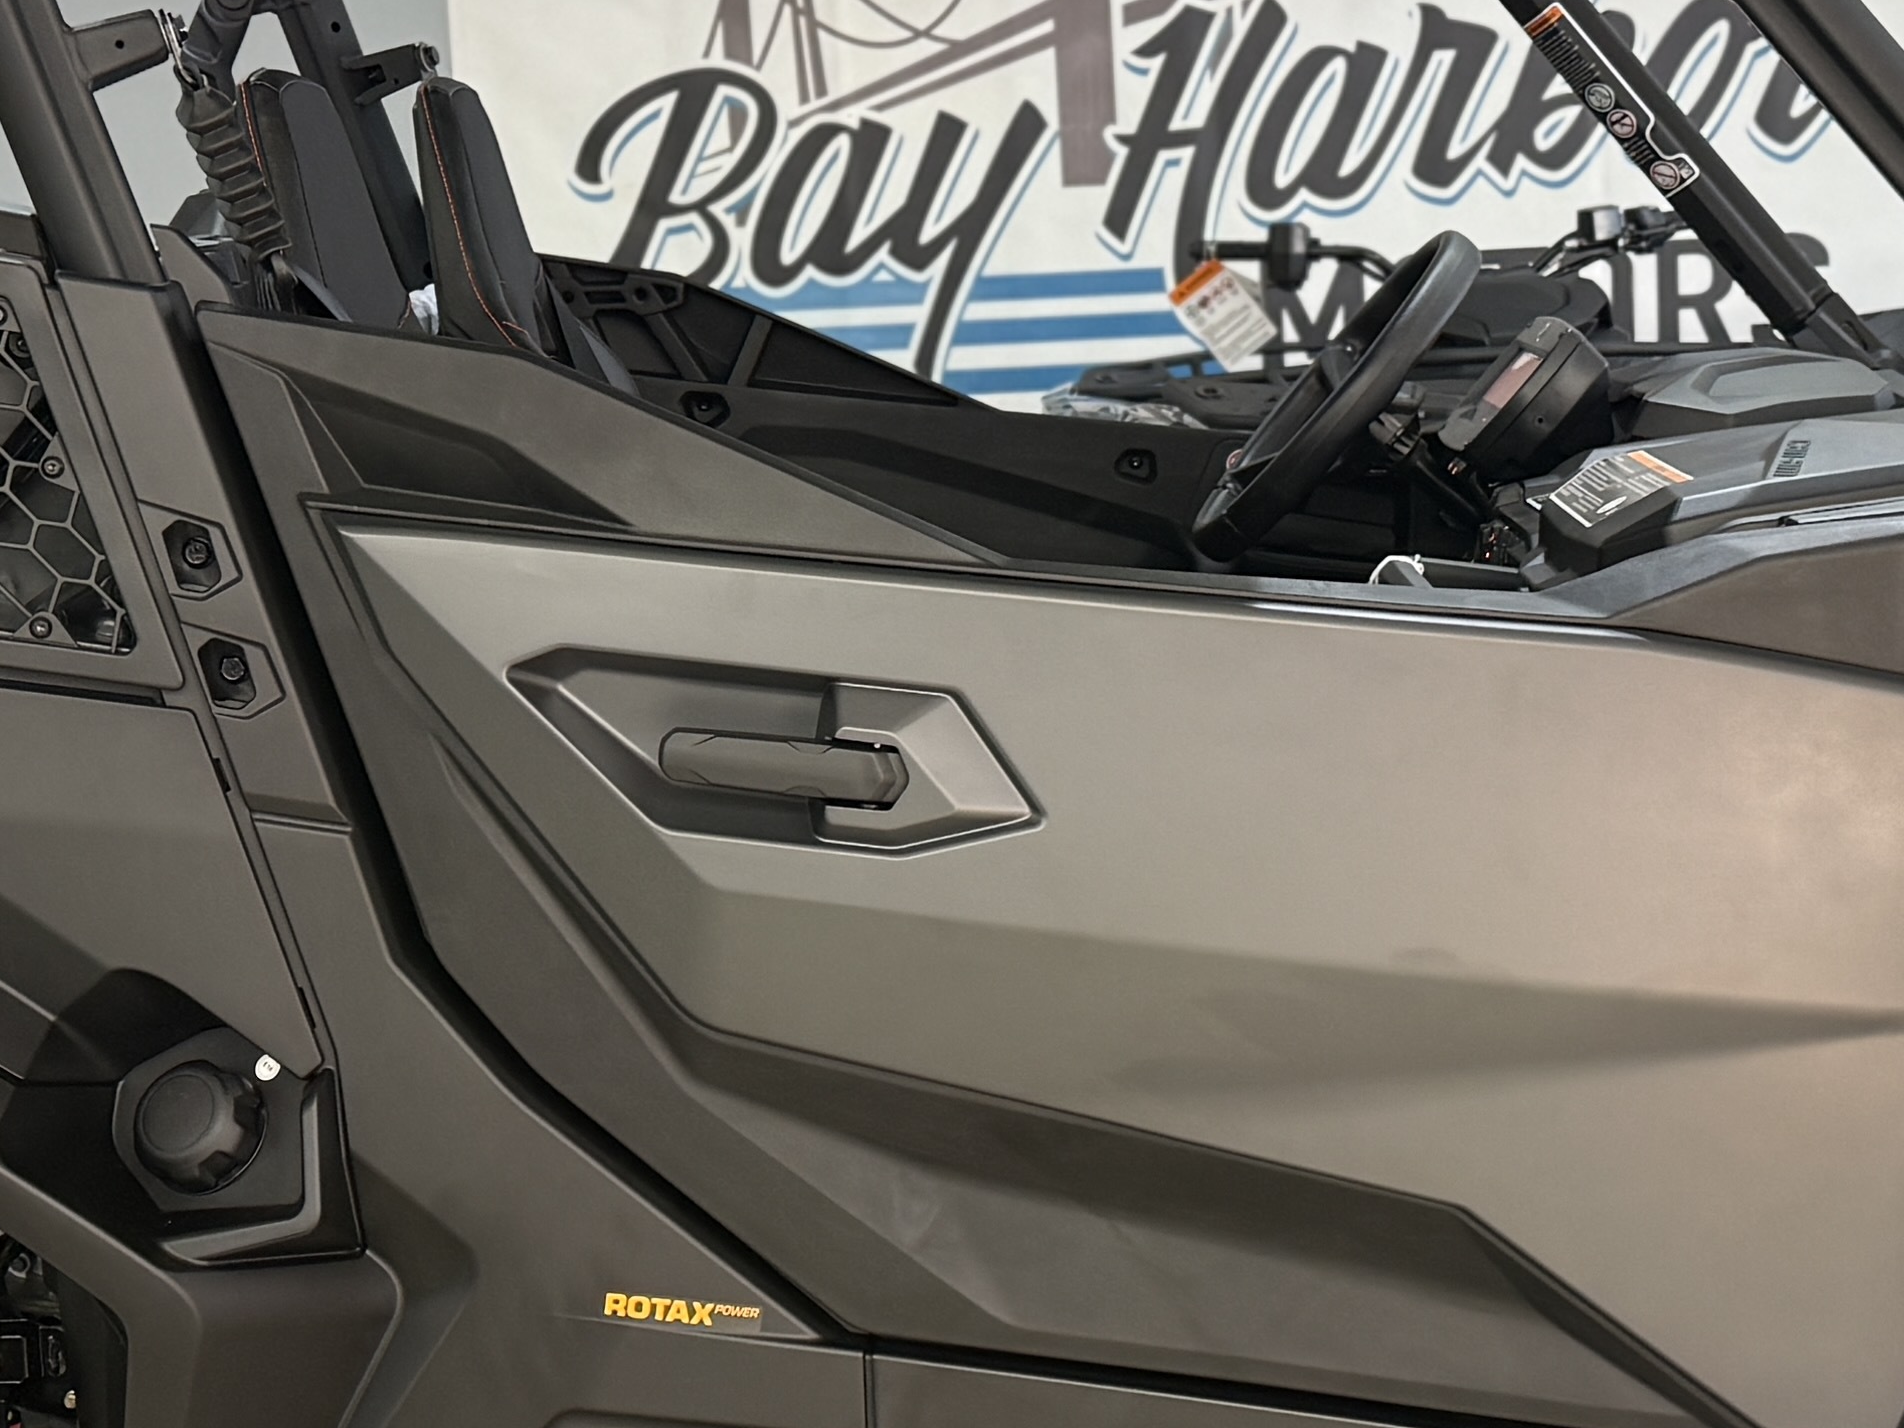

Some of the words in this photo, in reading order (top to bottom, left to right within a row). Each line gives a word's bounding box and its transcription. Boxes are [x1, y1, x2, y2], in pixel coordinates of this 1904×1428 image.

[574, 67, 1048, 380] Bay
[603, 1292, 715, 1327] ROTAX
[714, 1304, 761, 1319] POWER
